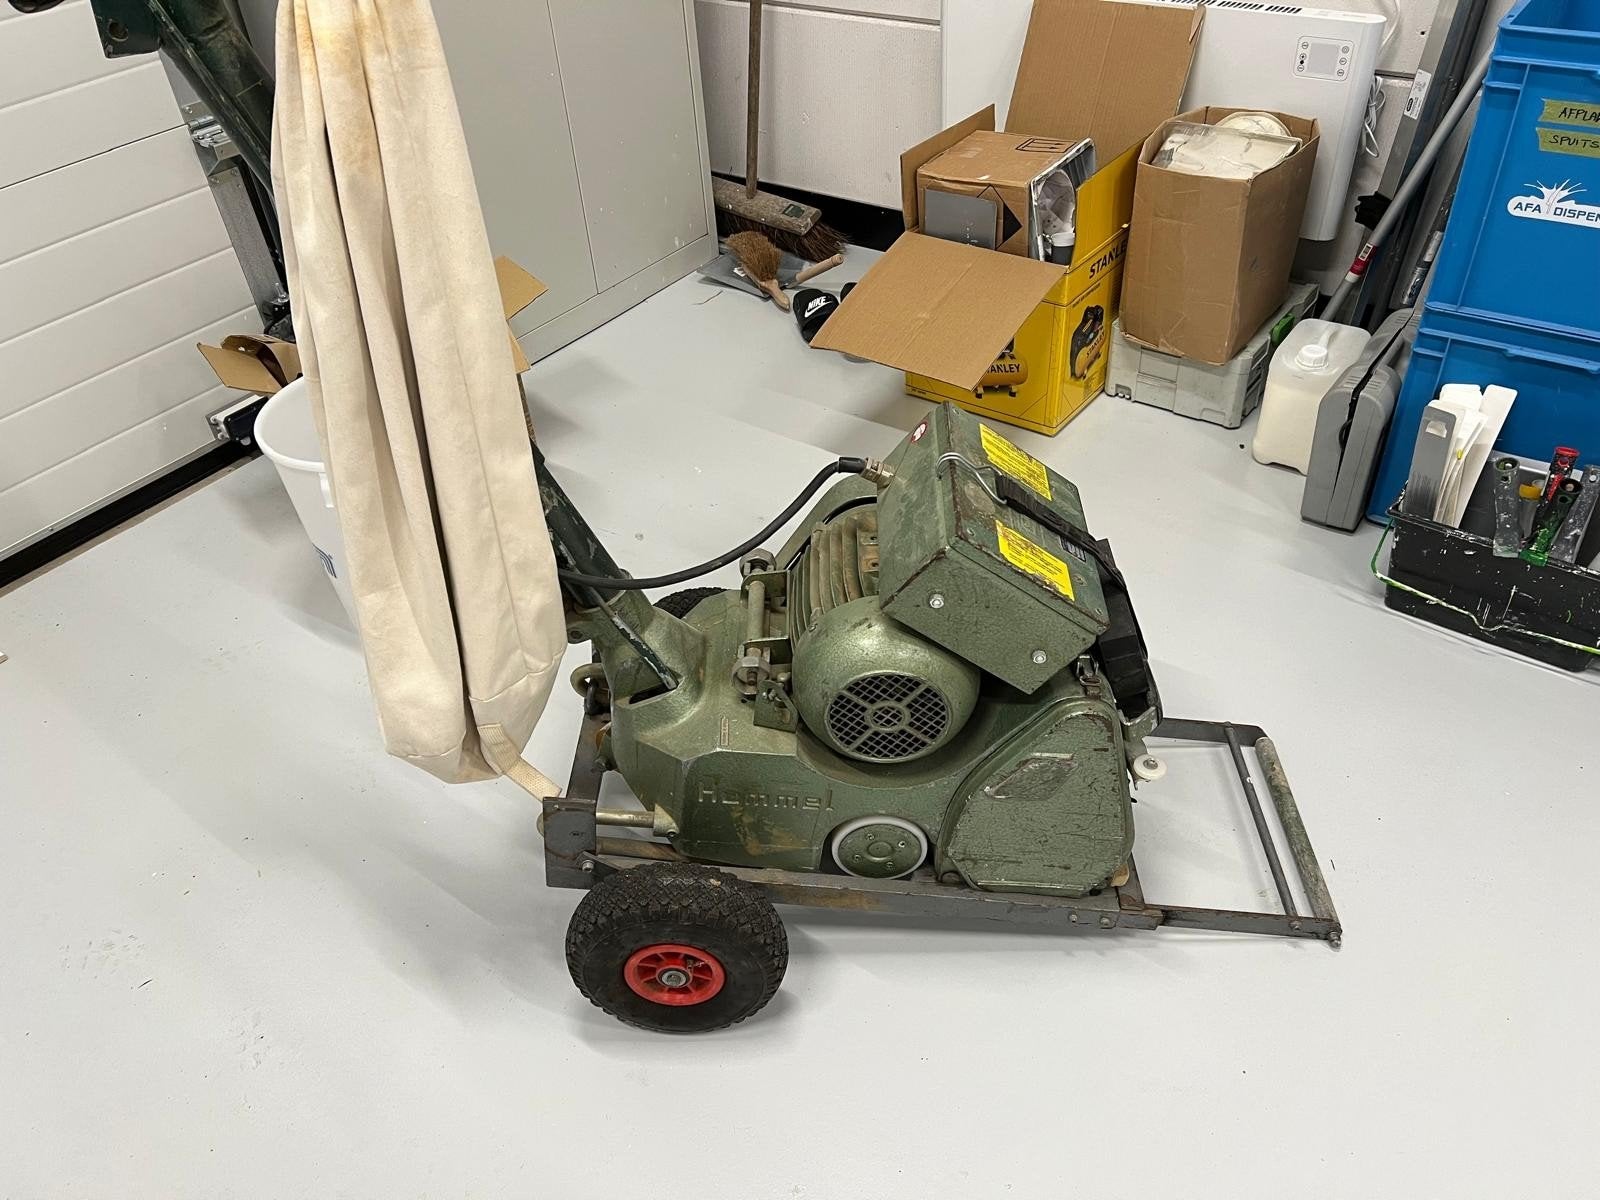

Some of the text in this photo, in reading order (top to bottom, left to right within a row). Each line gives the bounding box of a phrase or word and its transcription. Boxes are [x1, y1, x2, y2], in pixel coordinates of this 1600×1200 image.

[1549, 135, 1600, 148] SPUITS
[1513, 201, 1542, 214] AFA
[1089, 238, 1127, 279] STANLE
[807, 296, 827, 311] NIKE
[987, 363, 1020, 374] ANLEY
